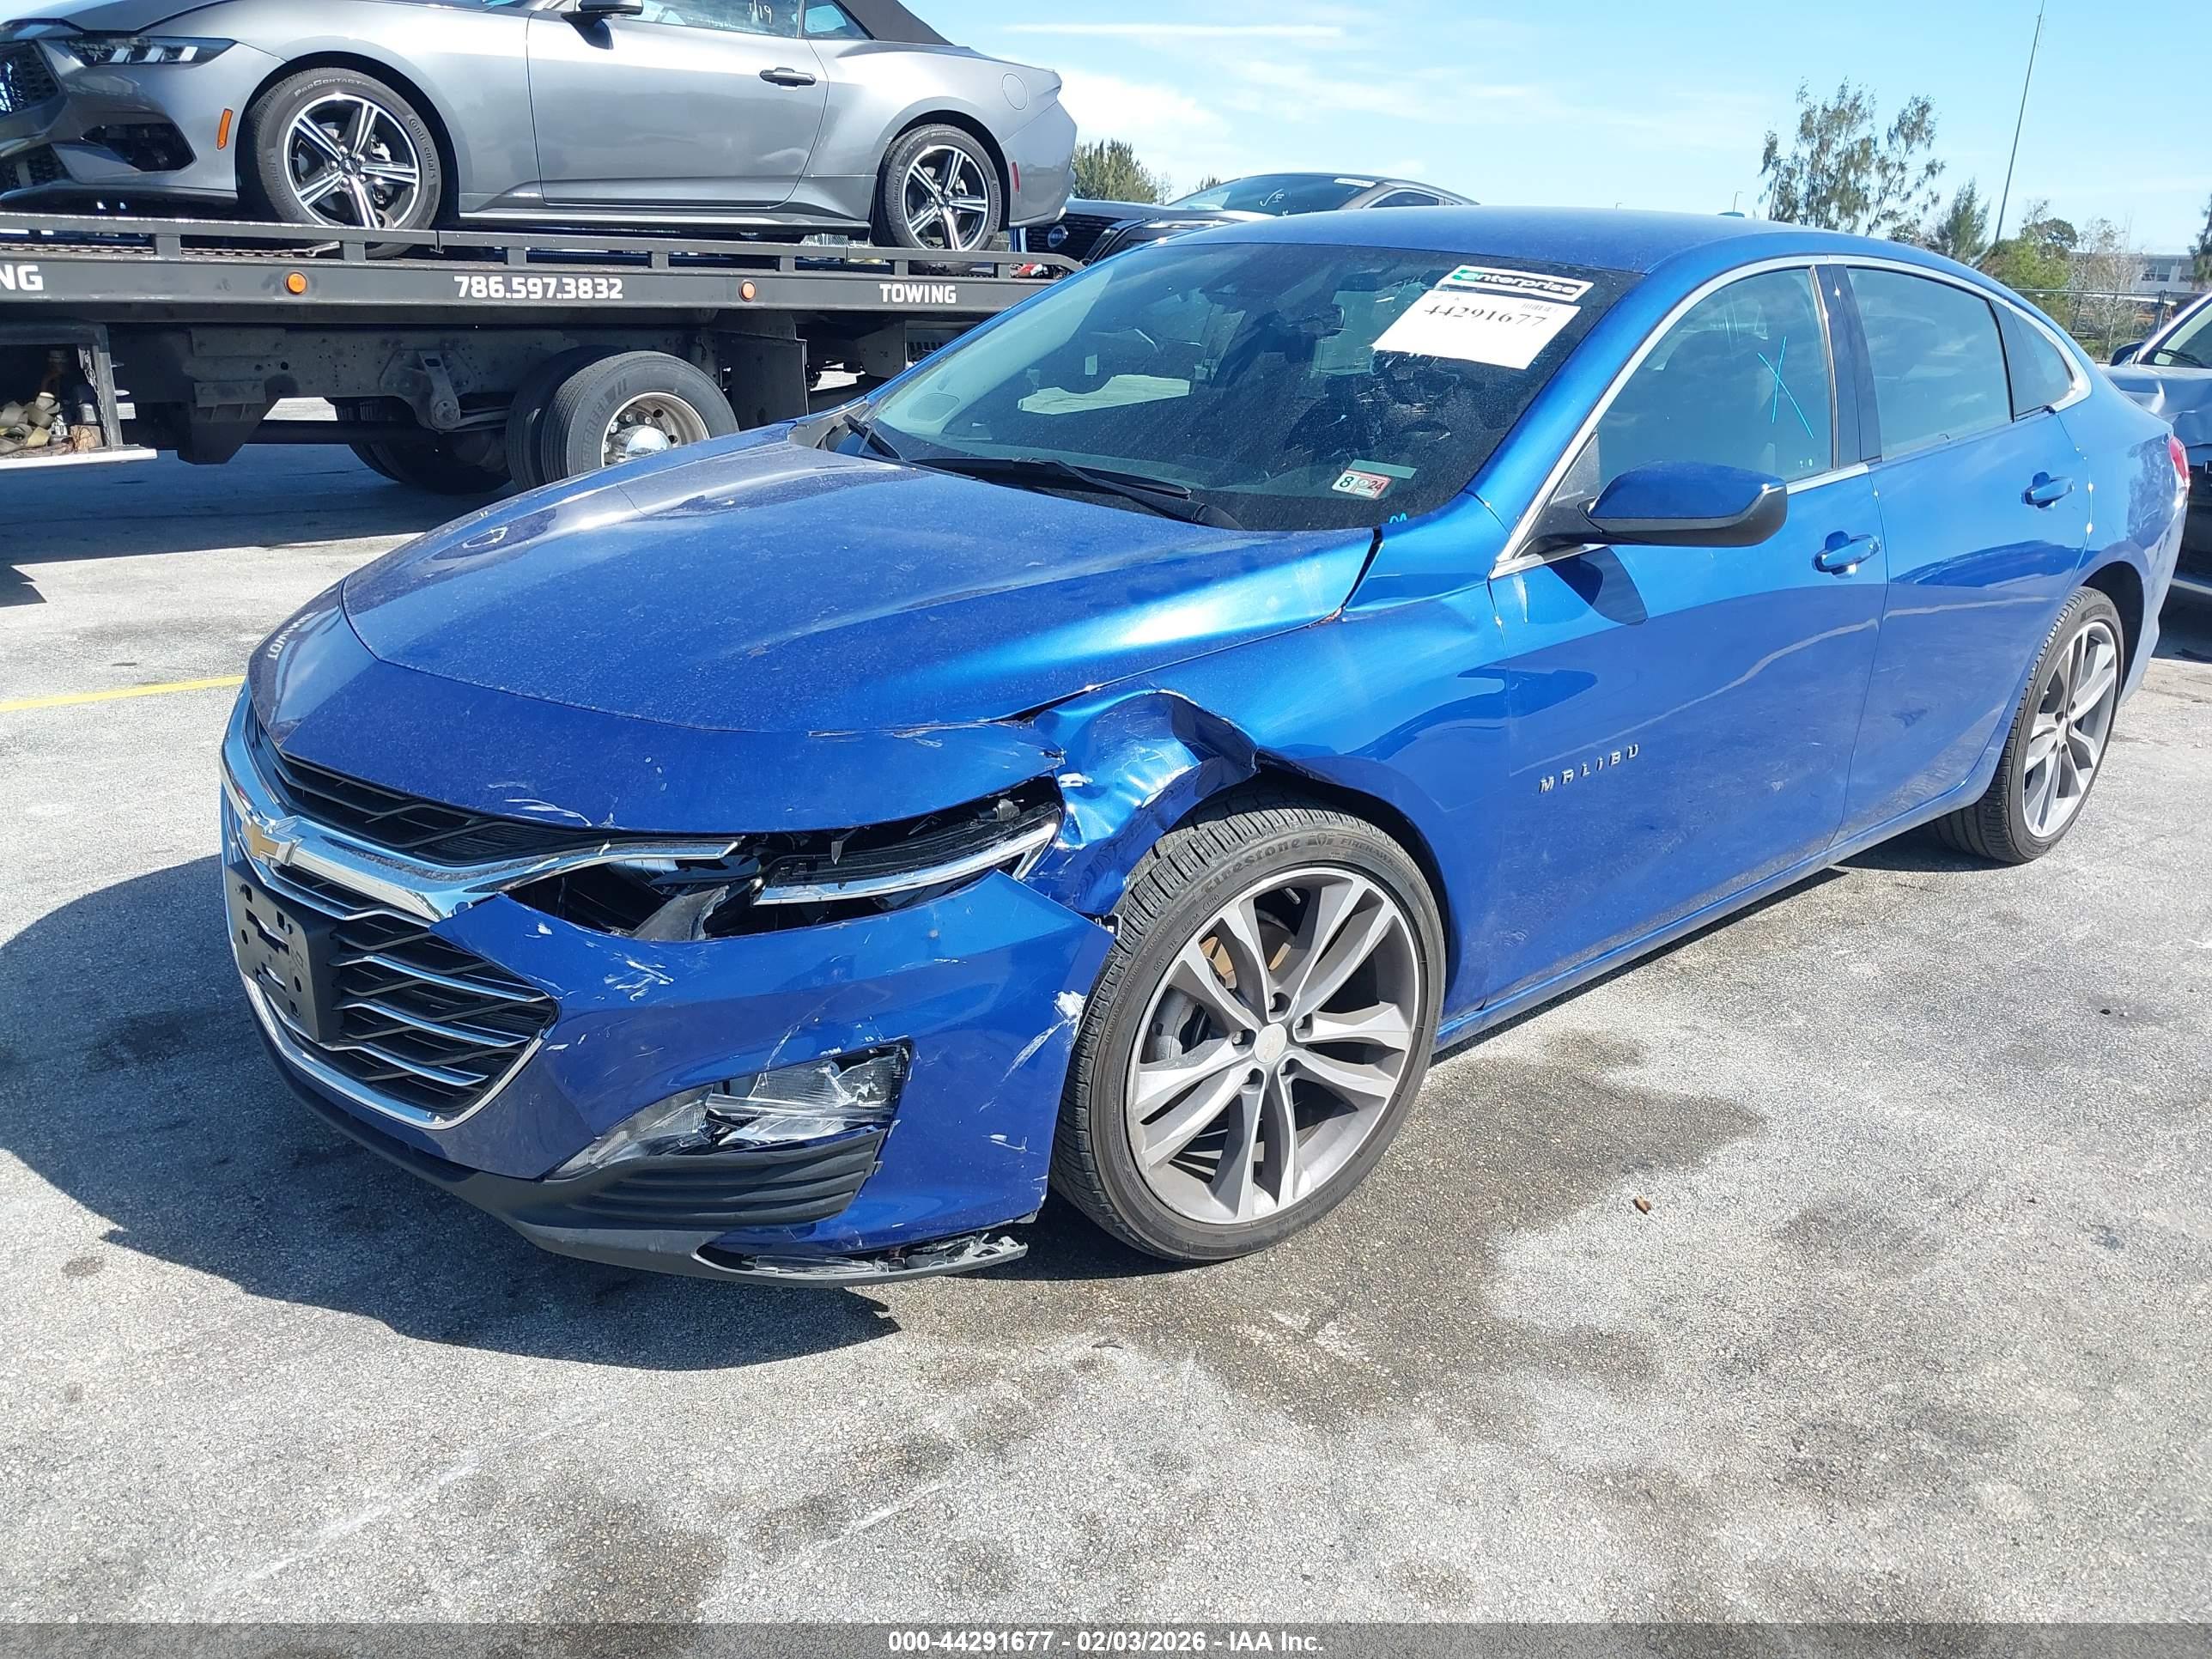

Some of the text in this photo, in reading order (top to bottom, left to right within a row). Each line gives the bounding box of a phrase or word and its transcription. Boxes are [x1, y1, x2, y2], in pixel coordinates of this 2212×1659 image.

[453, 276, 623, 300] 786.597.3832
[879, 283, 957, 304] TOWING
[1459, 270, 1579, 295] enterprise
[1424, 304, 1548, 327] 44291677
[1340, 477, 1384, 491] 8 24
[1538, 743, 1639, 793] MALIBU
[1340, 838, 1395, 866] FIREHAWK
[1201, 838, 1301, 894] Firestone
